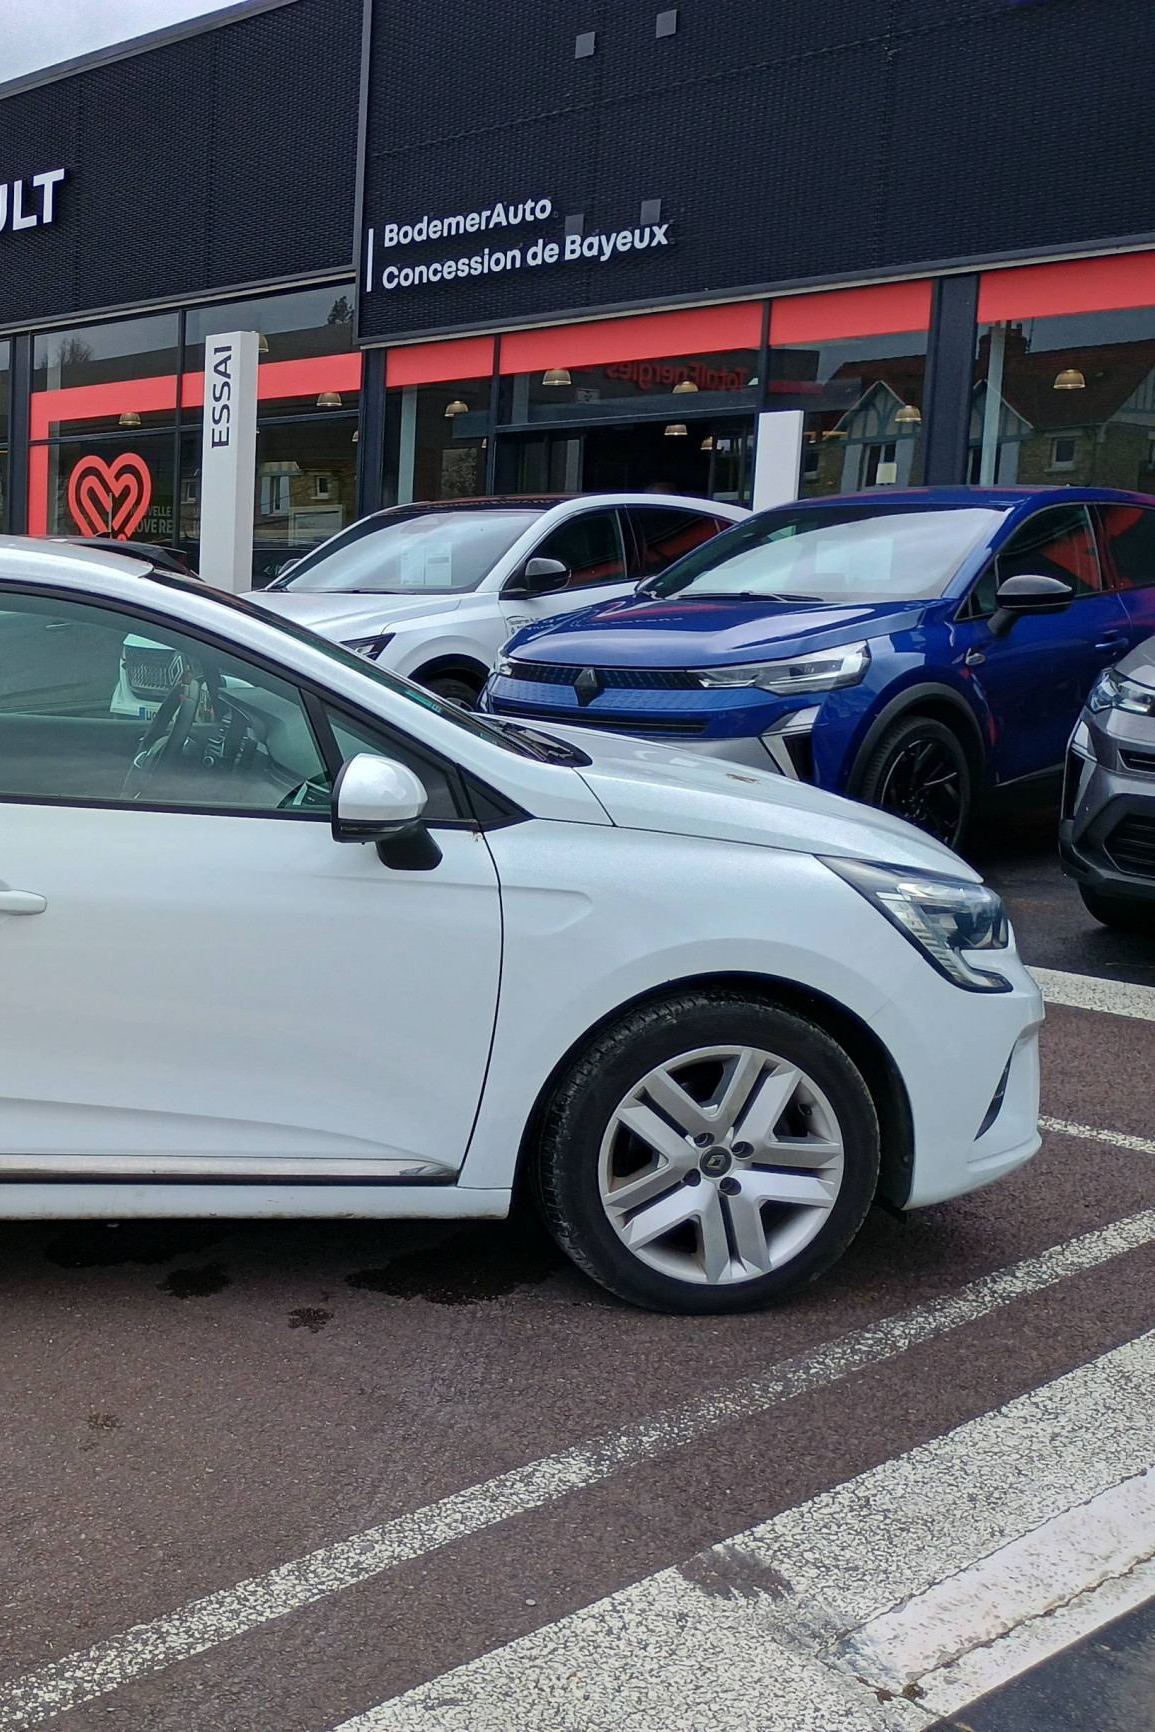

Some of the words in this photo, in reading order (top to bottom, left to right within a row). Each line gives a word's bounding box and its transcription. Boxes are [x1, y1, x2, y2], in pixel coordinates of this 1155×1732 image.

[384, 198, 552, 247] BodemerAuto
[382, 248, 521, 289] Concession
[526, 239, 559, 266] de
[564, 223, 670, 262] Bayeux
[211, 345, 232, 449] ESSAI
[130, 505, 172, 517] NVELLE
[134, 518, 157, 534] OVE
